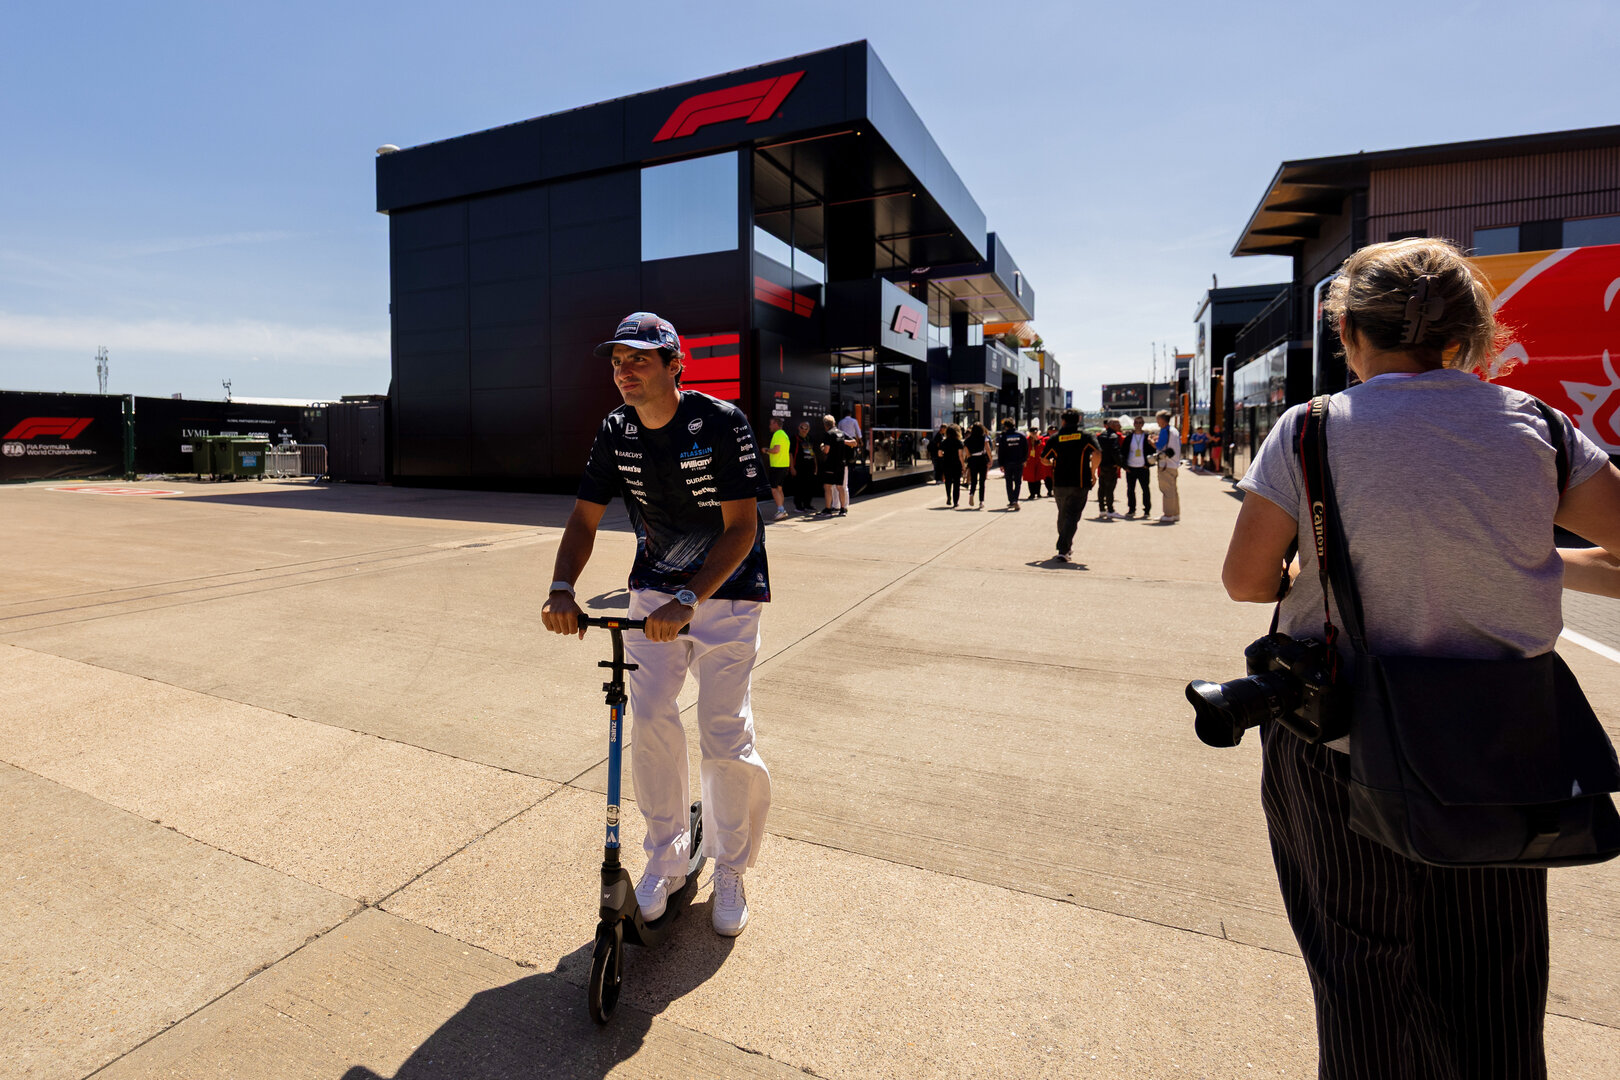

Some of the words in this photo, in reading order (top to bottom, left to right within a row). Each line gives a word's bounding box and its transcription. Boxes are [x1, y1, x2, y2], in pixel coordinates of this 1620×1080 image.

[652, 70, 806, 143] F1
[2, 417, 95, 440] F1
[182, 429, 209, 437] LVMH
[3, 444, 24, 455] FIA
[686, 474, 714, 485] DURACEL
[1312, 501, 1324, 557] Canon
